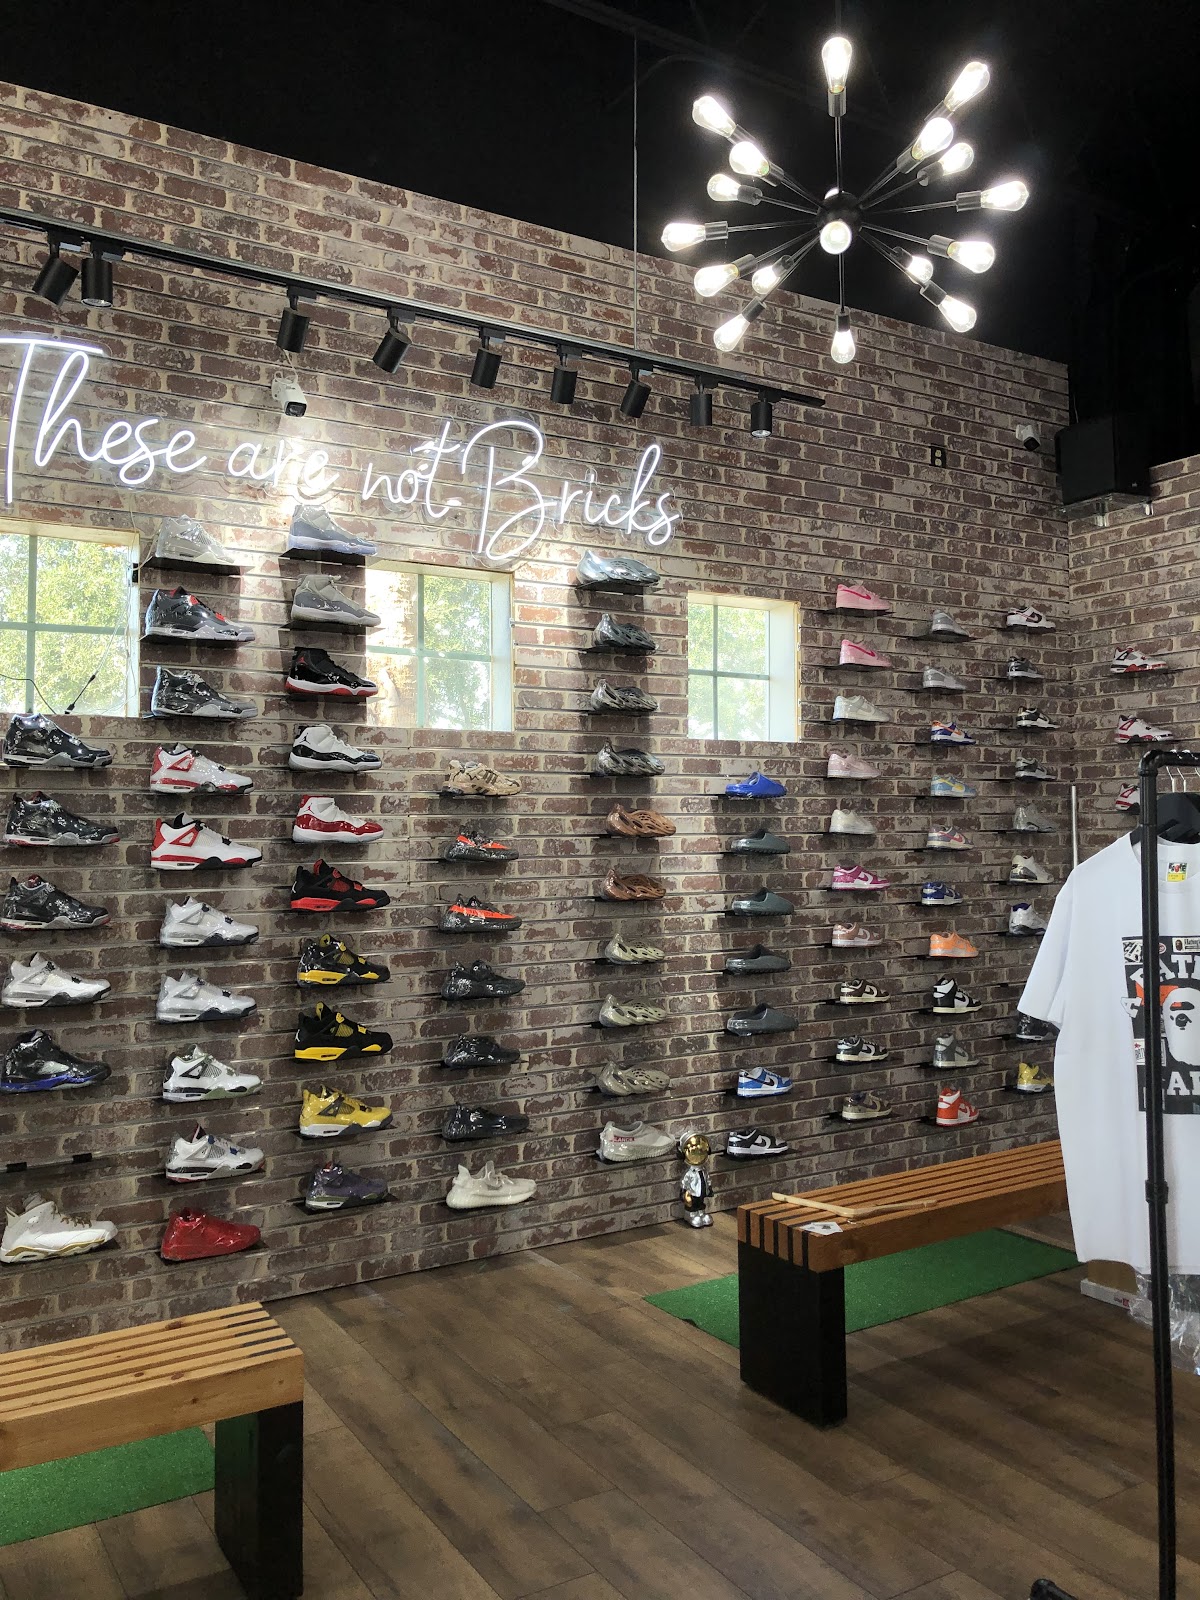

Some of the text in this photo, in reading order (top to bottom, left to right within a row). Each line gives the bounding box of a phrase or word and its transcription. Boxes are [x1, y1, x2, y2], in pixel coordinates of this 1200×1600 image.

[0, 337, 680, 560] These are not Bricks
